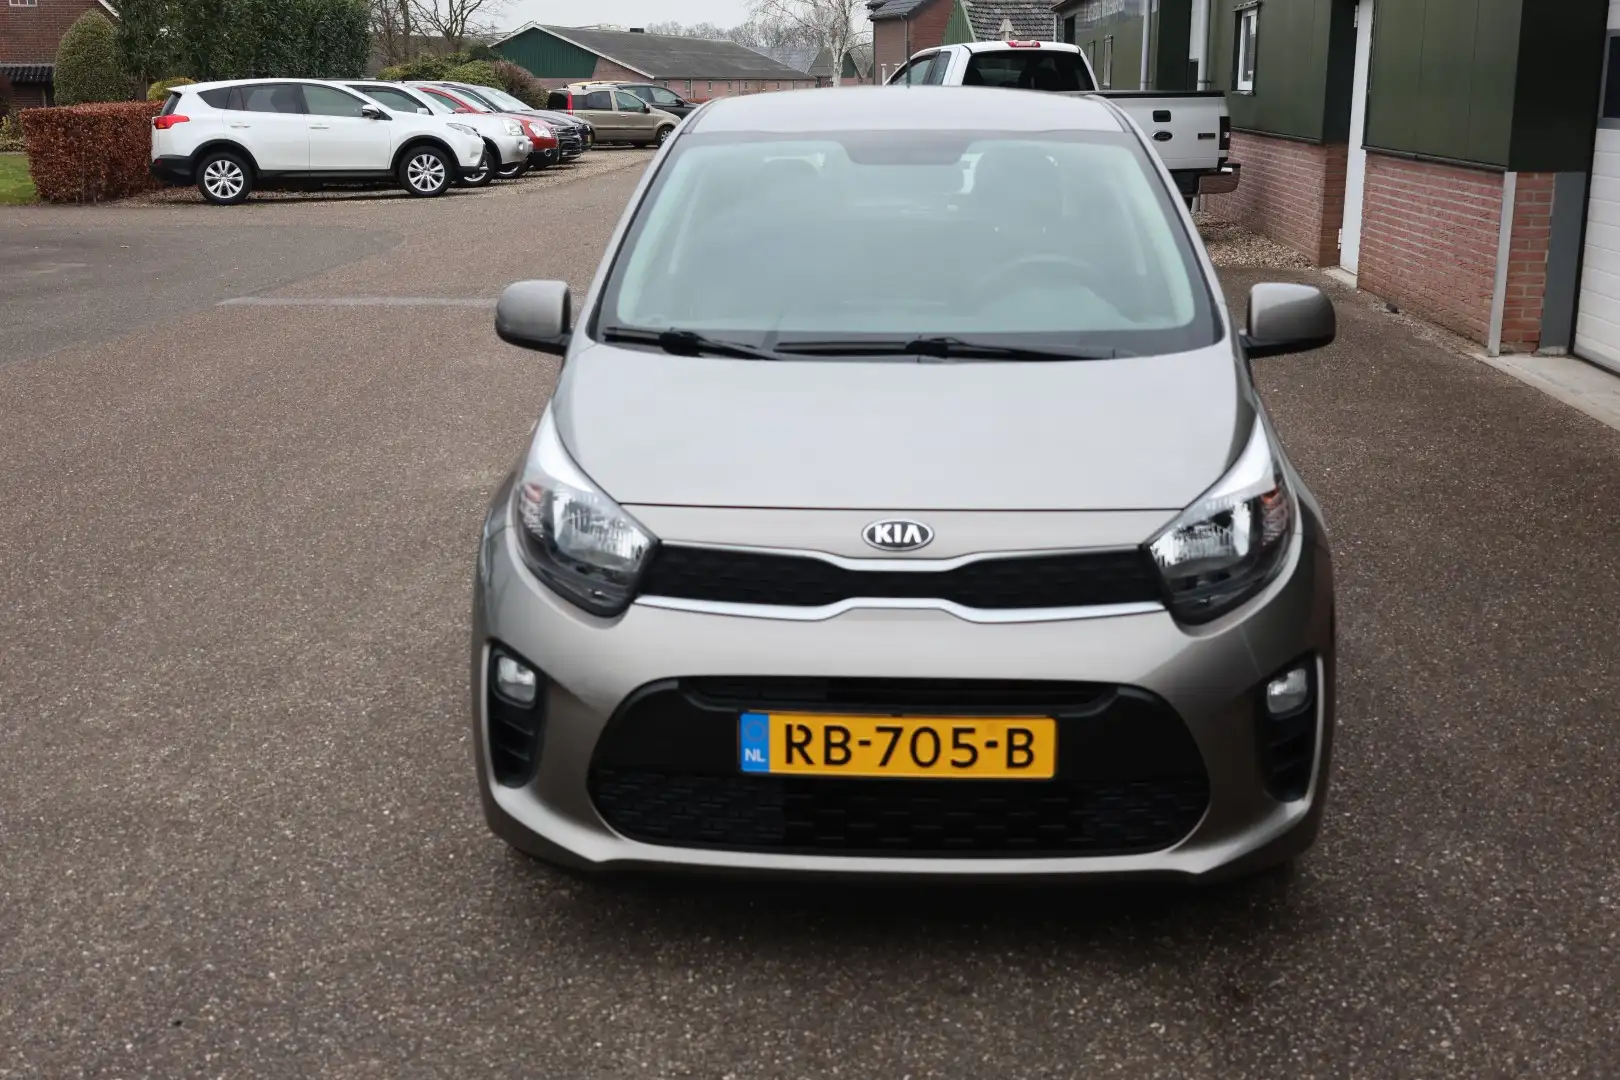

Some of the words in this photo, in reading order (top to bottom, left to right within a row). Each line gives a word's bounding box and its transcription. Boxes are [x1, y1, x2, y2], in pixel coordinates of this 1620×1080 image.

[874, 523, 922, 544] KIA
[744, 748, 766, 762] NL
[784, 723, 1034, 769] RB-705-B
